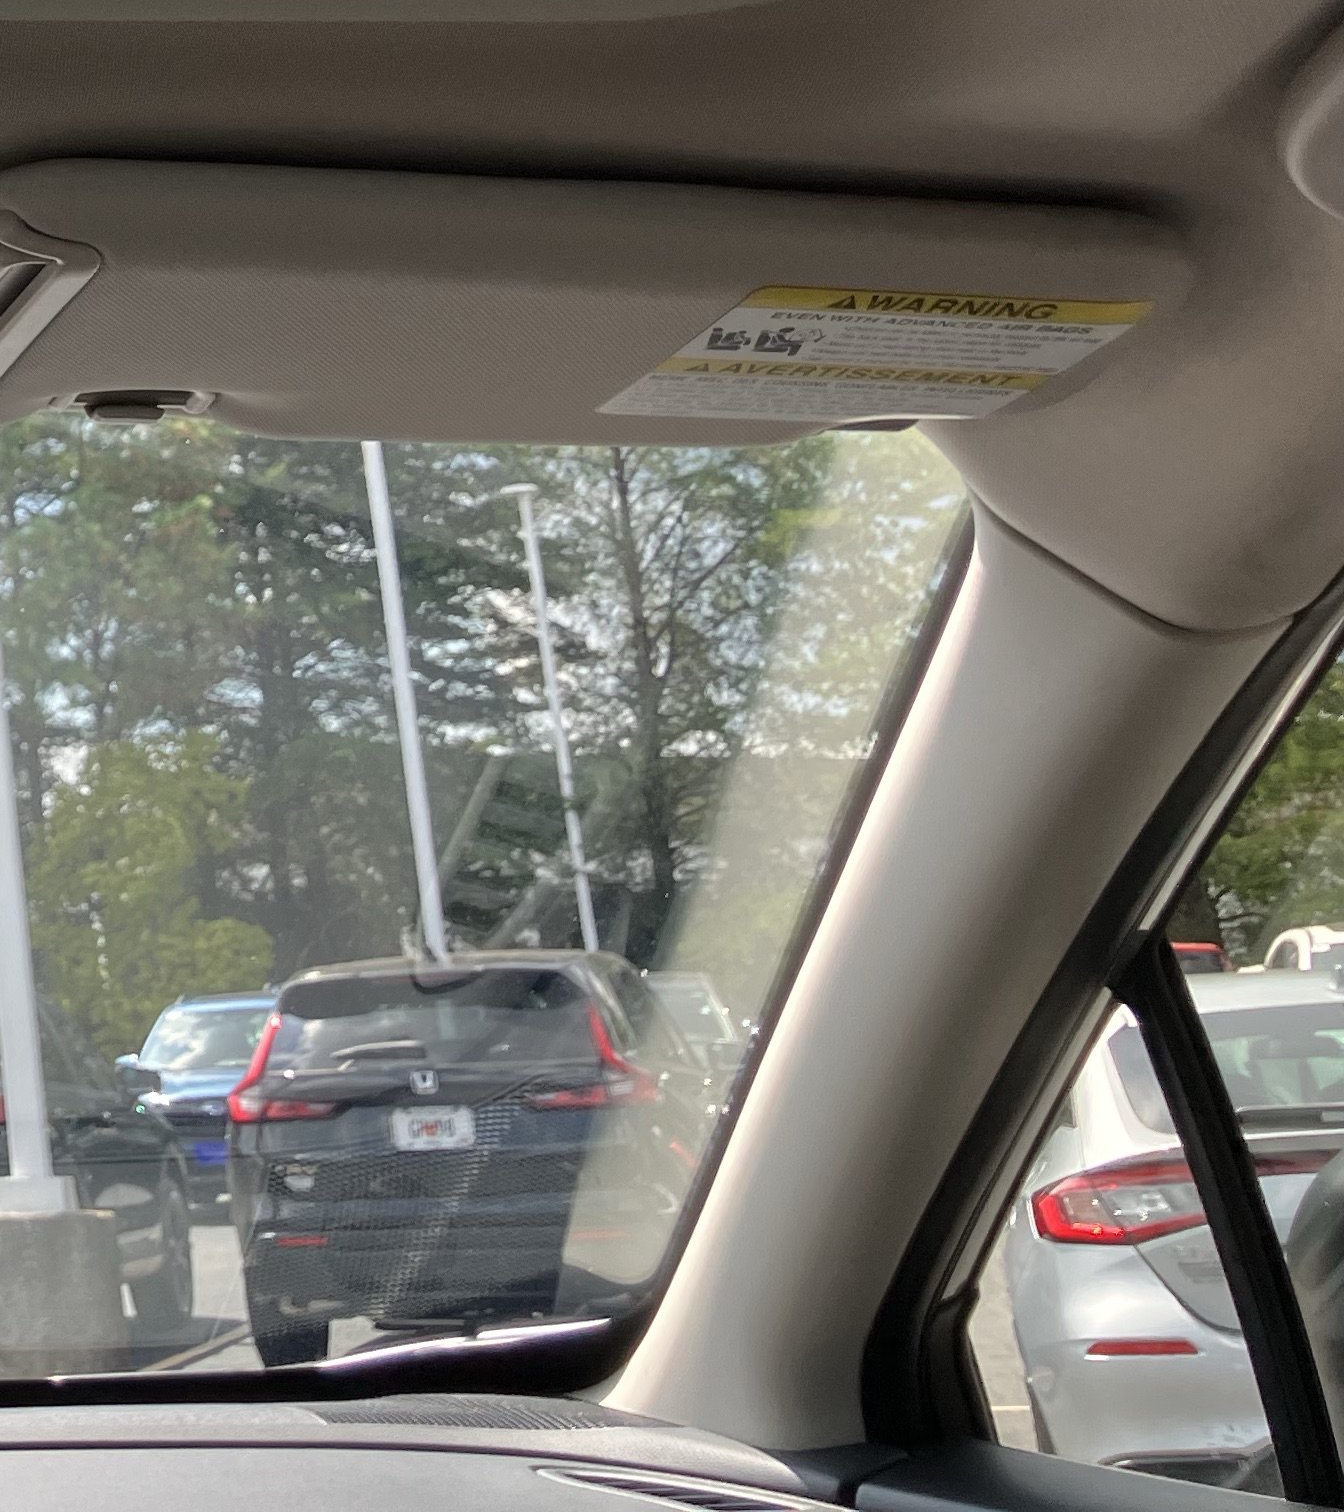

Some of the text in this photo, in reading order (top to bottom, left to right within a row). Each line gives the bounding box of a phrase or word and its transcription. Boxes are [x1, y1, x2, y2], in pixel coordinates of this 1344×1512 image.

[866, 294, 1059, 320] WARNING
[770, 311, 827, 321] EVEN
[829, 314, 881, 324] WITH
[884, 317, 994, 331] ADVANCED
[717, 362, 1023, 387] AVERTISSEMENT
